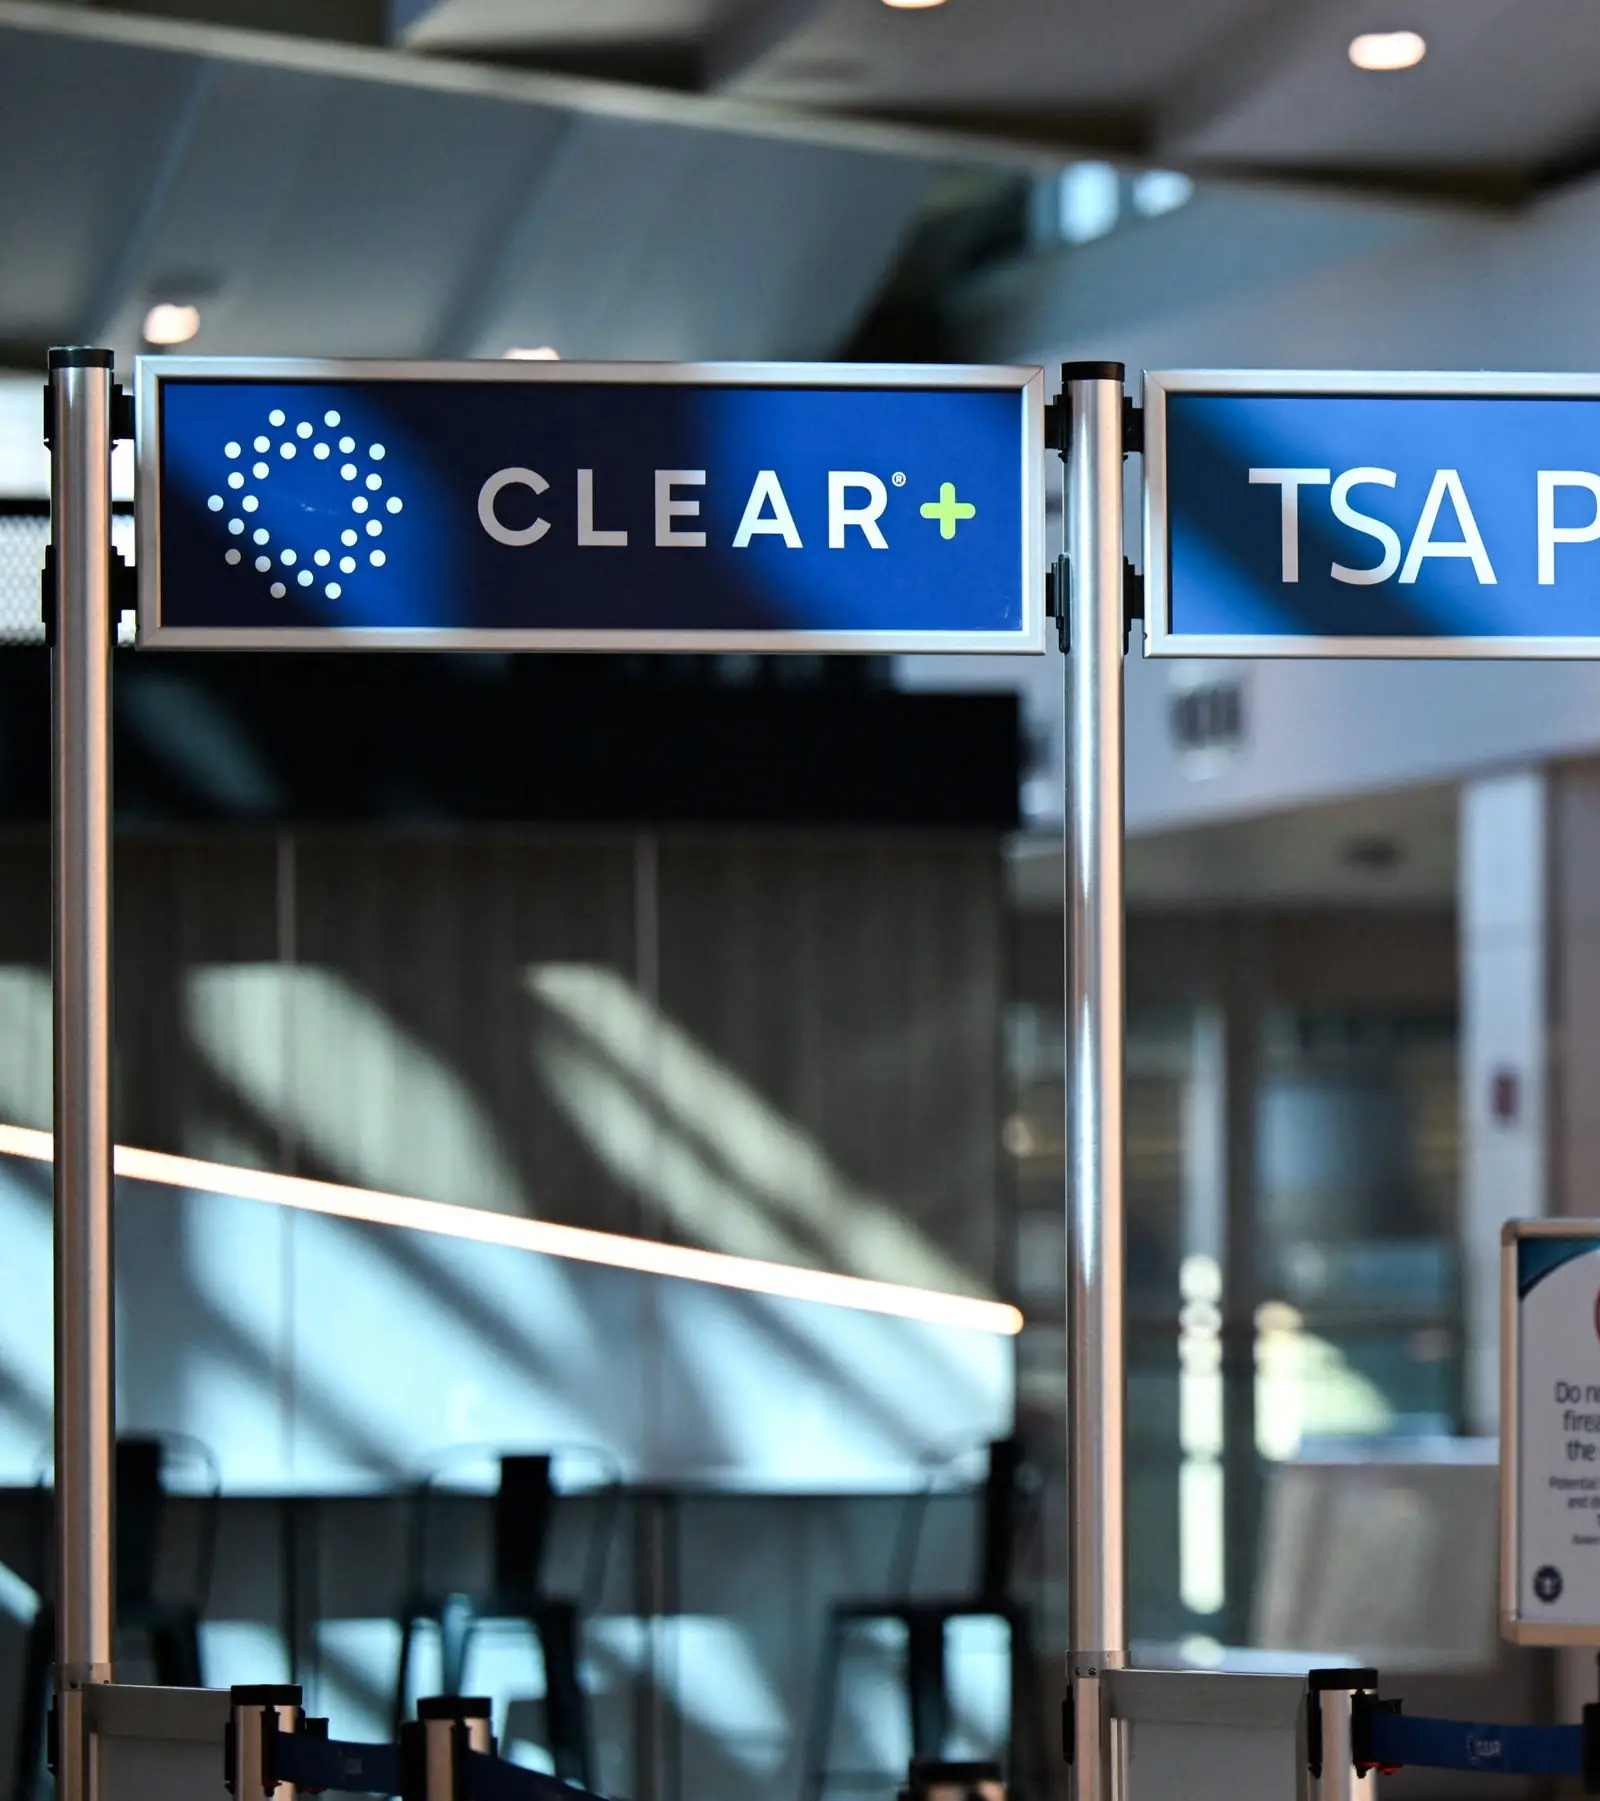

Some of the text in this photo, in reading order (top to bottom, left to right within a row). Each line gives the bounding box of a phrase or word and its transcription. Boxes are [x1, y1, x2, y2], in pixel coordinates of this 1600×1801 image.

[1248, 466, 1498, 585] TSA
[1555, 1381, 1581, 1404] Do
[1566, 1440, 1597, 1462] the
